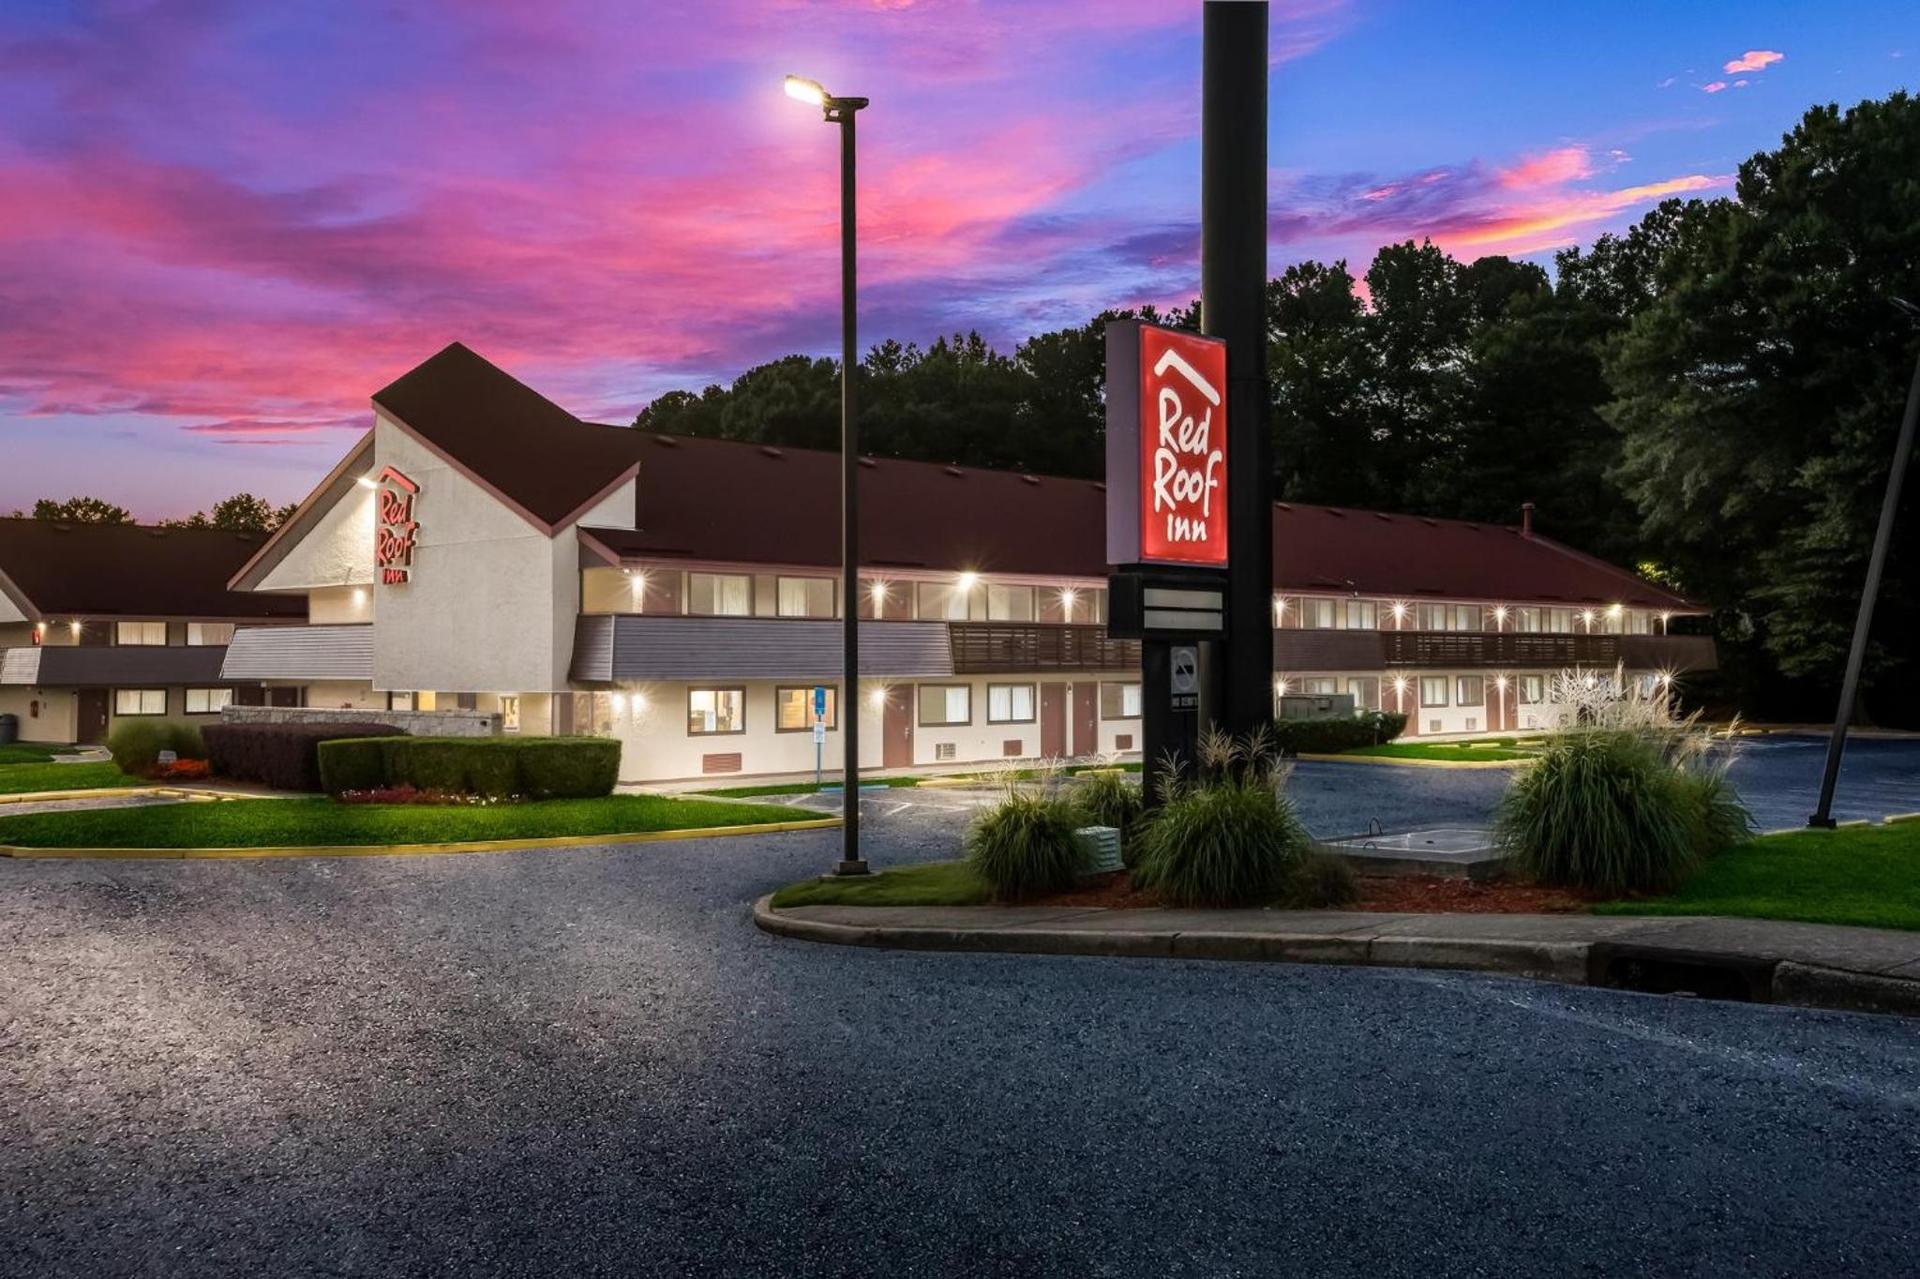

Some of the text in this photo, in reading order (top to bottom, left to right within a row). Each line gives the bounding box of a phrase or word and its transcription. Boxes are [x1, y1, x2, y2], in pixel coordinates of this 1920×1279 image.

[1159, 388, 1211, 455] Red
[379, 489, 413, 526] Red
[1153, 448, 1222, 517] Roof
[377, 521, 420, 567] Roof
